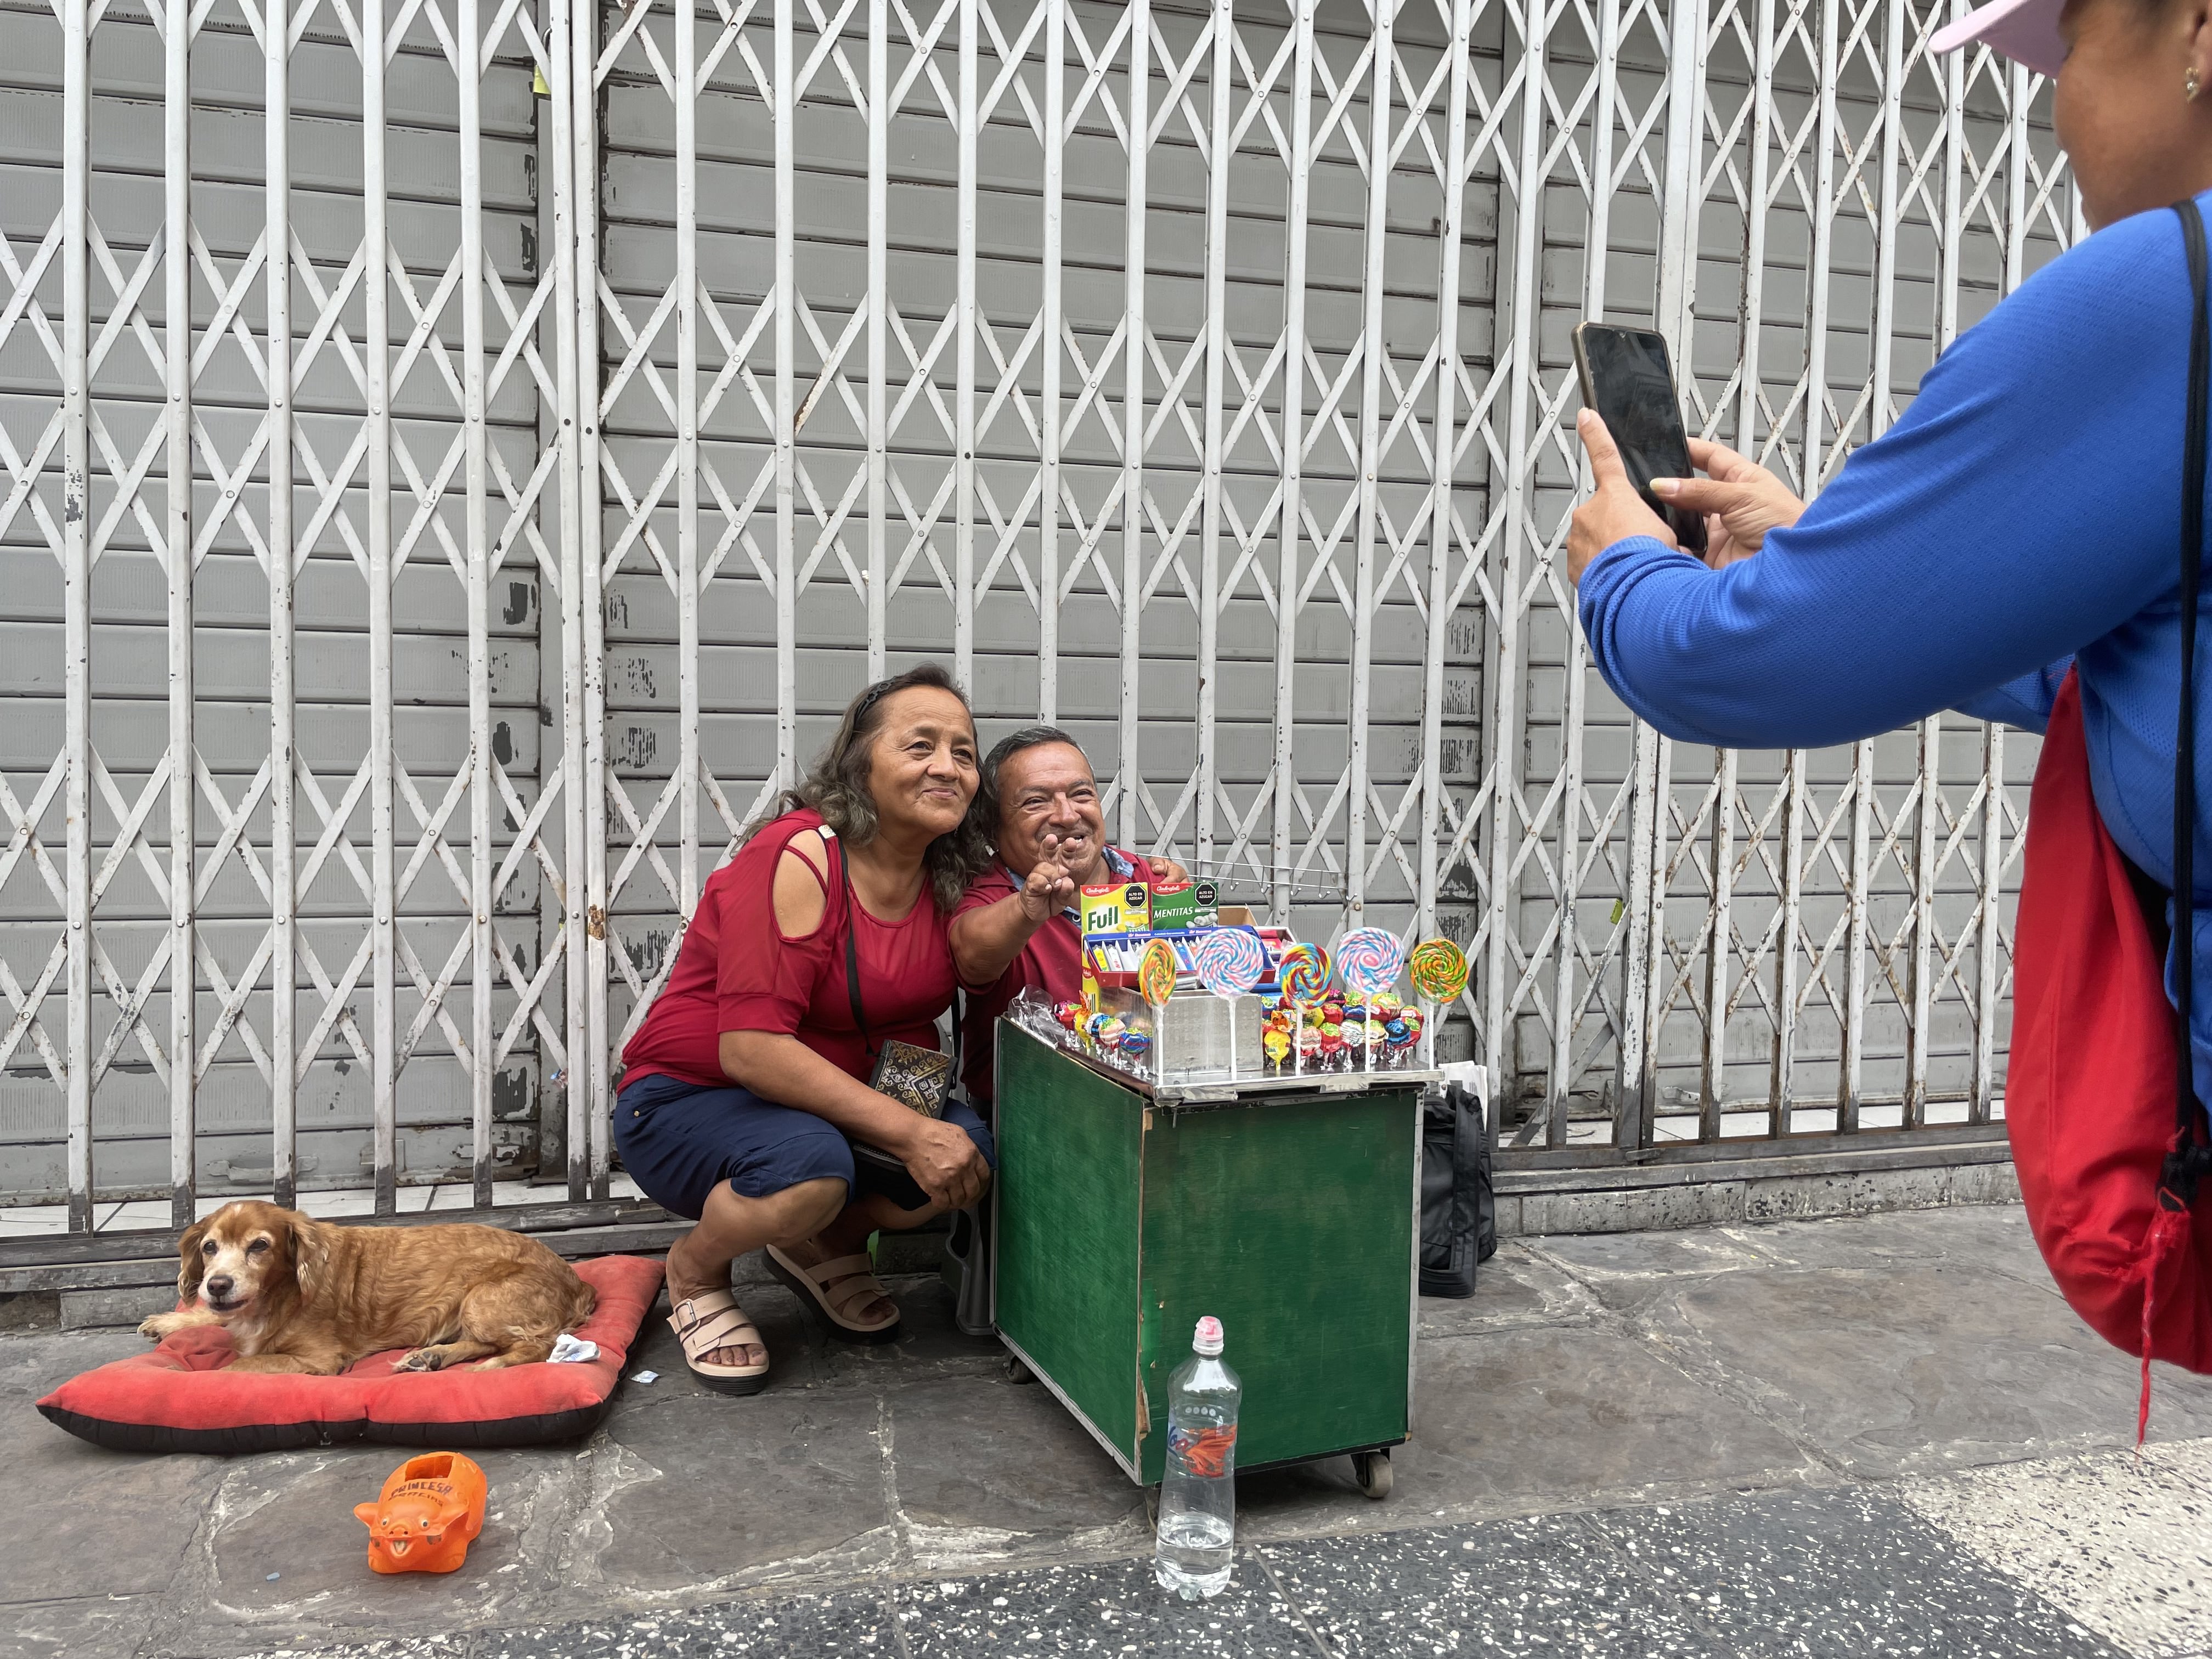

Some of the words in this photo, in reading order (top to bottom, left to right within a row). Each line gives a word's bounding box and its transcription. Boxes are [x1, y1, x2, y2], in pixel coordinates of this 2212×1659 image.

[1088, 906, 1118, 932] Full
[1154, 907, 1193, 919] MENTITAS
[391, 1482, 453, 1497] PRINCESA
